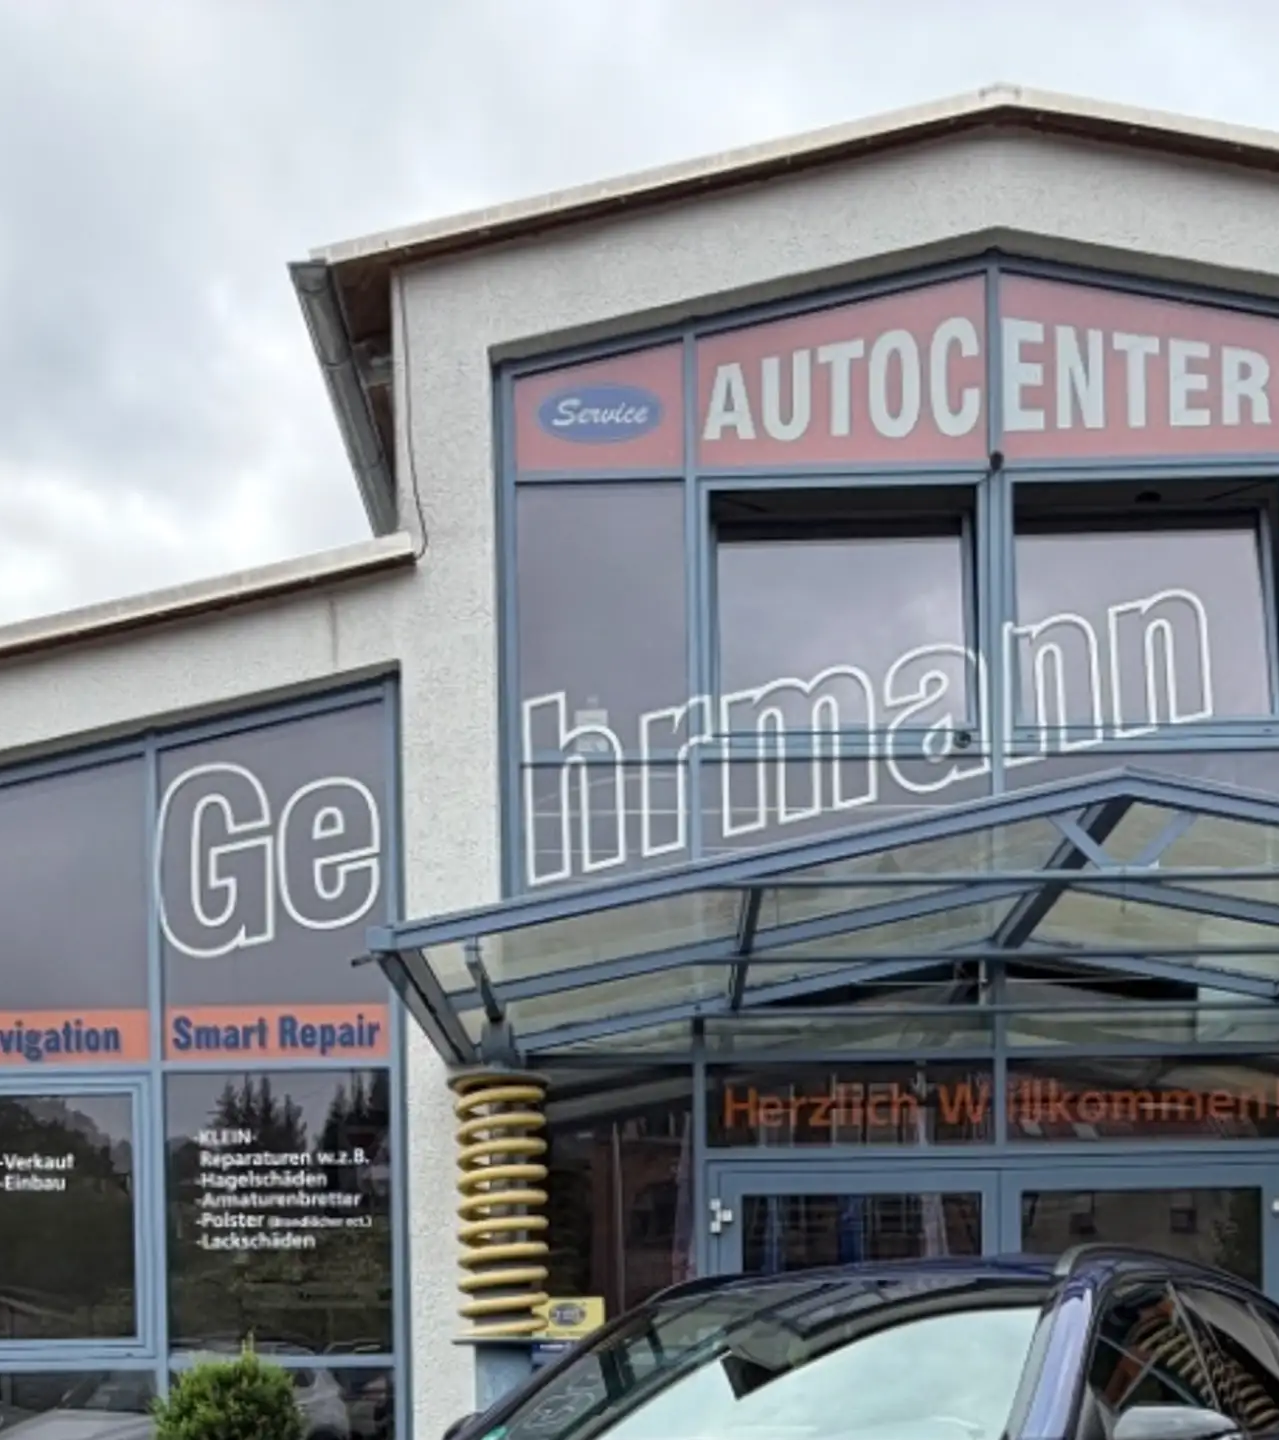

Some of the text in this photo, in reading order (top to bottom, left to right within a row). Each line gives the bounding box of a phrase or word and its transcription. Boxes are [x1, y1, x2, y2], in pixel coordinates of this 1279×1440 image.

[703, 316, 1273, 441] AUTOCENTER
[552, 397, 651, 428] Service
[172, 1013, 381, 1056] Smart Repair
[724, 1080, 919, 1129] Herzlich
[199, 1149, 312, 1171] Reparaturen
